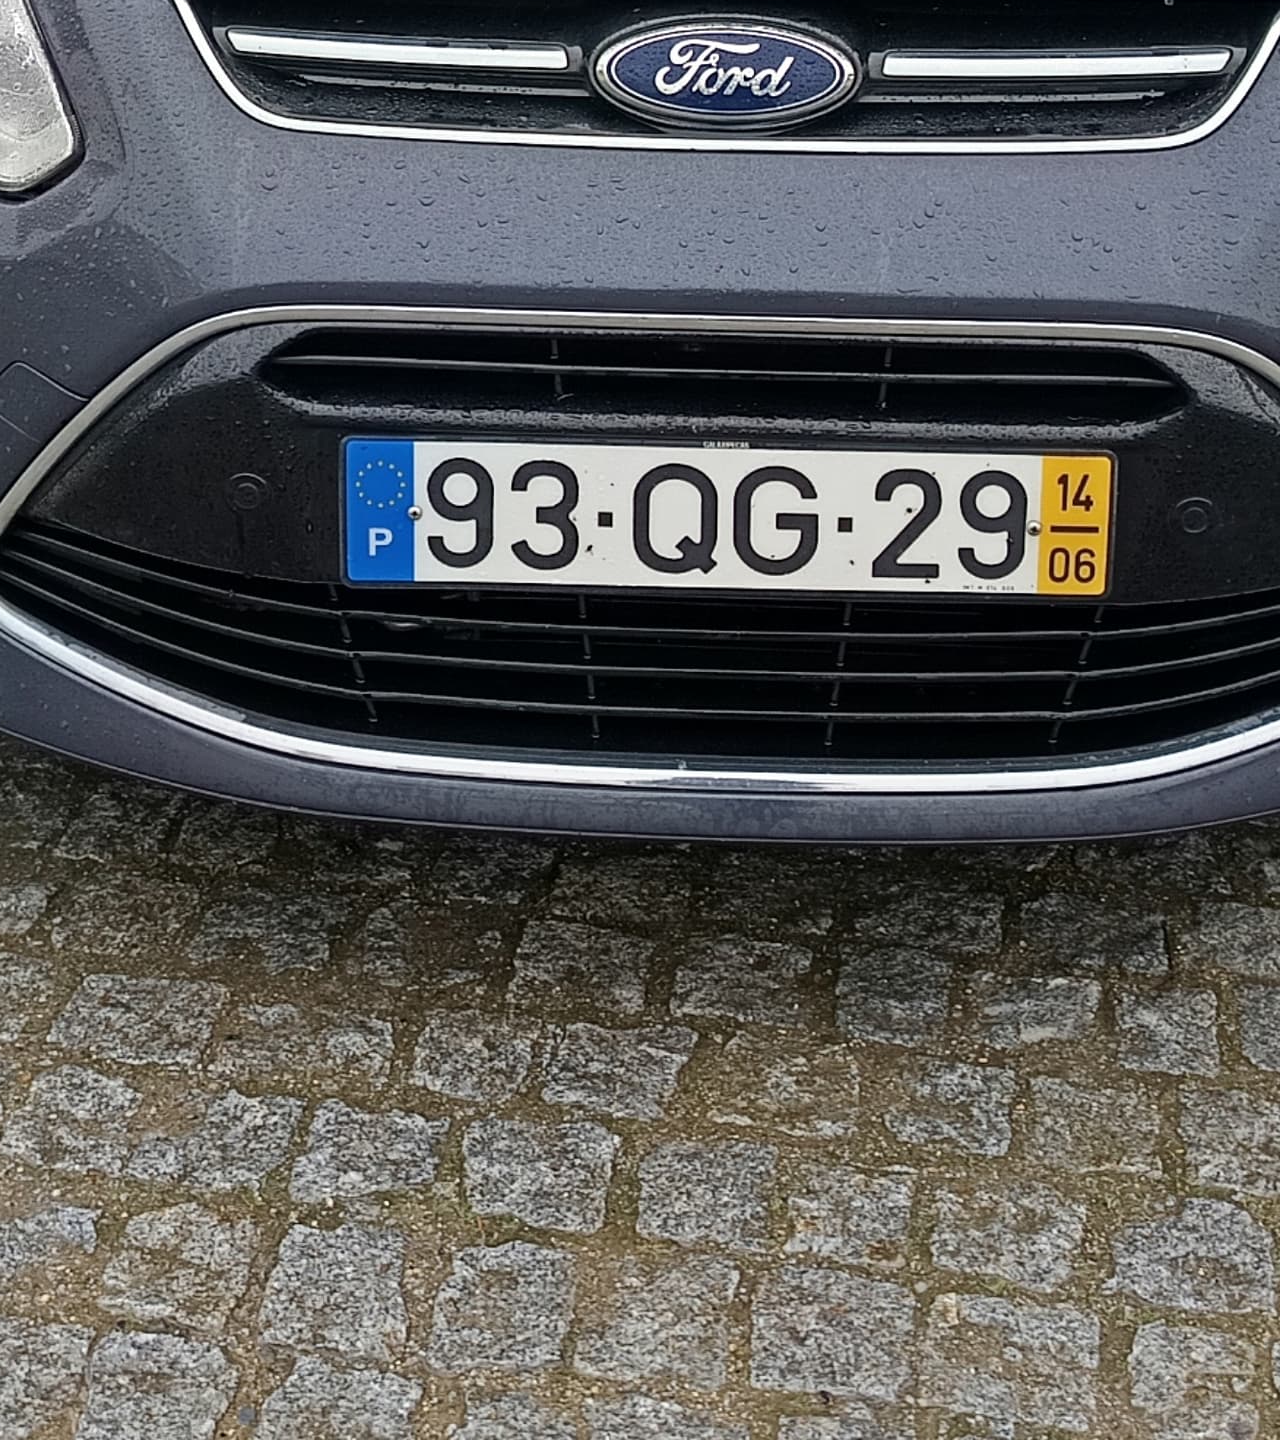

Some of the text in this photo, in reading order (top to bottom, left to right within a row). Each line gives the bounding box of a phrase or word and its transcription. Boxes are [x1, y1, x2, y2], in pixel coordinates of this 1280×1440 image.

[654, 39, 795, 98] Ford
[1056, 473, 1094, 512] 14
[369, 527, 393, 557] P
[1048, 547, 1096, 584] 06
